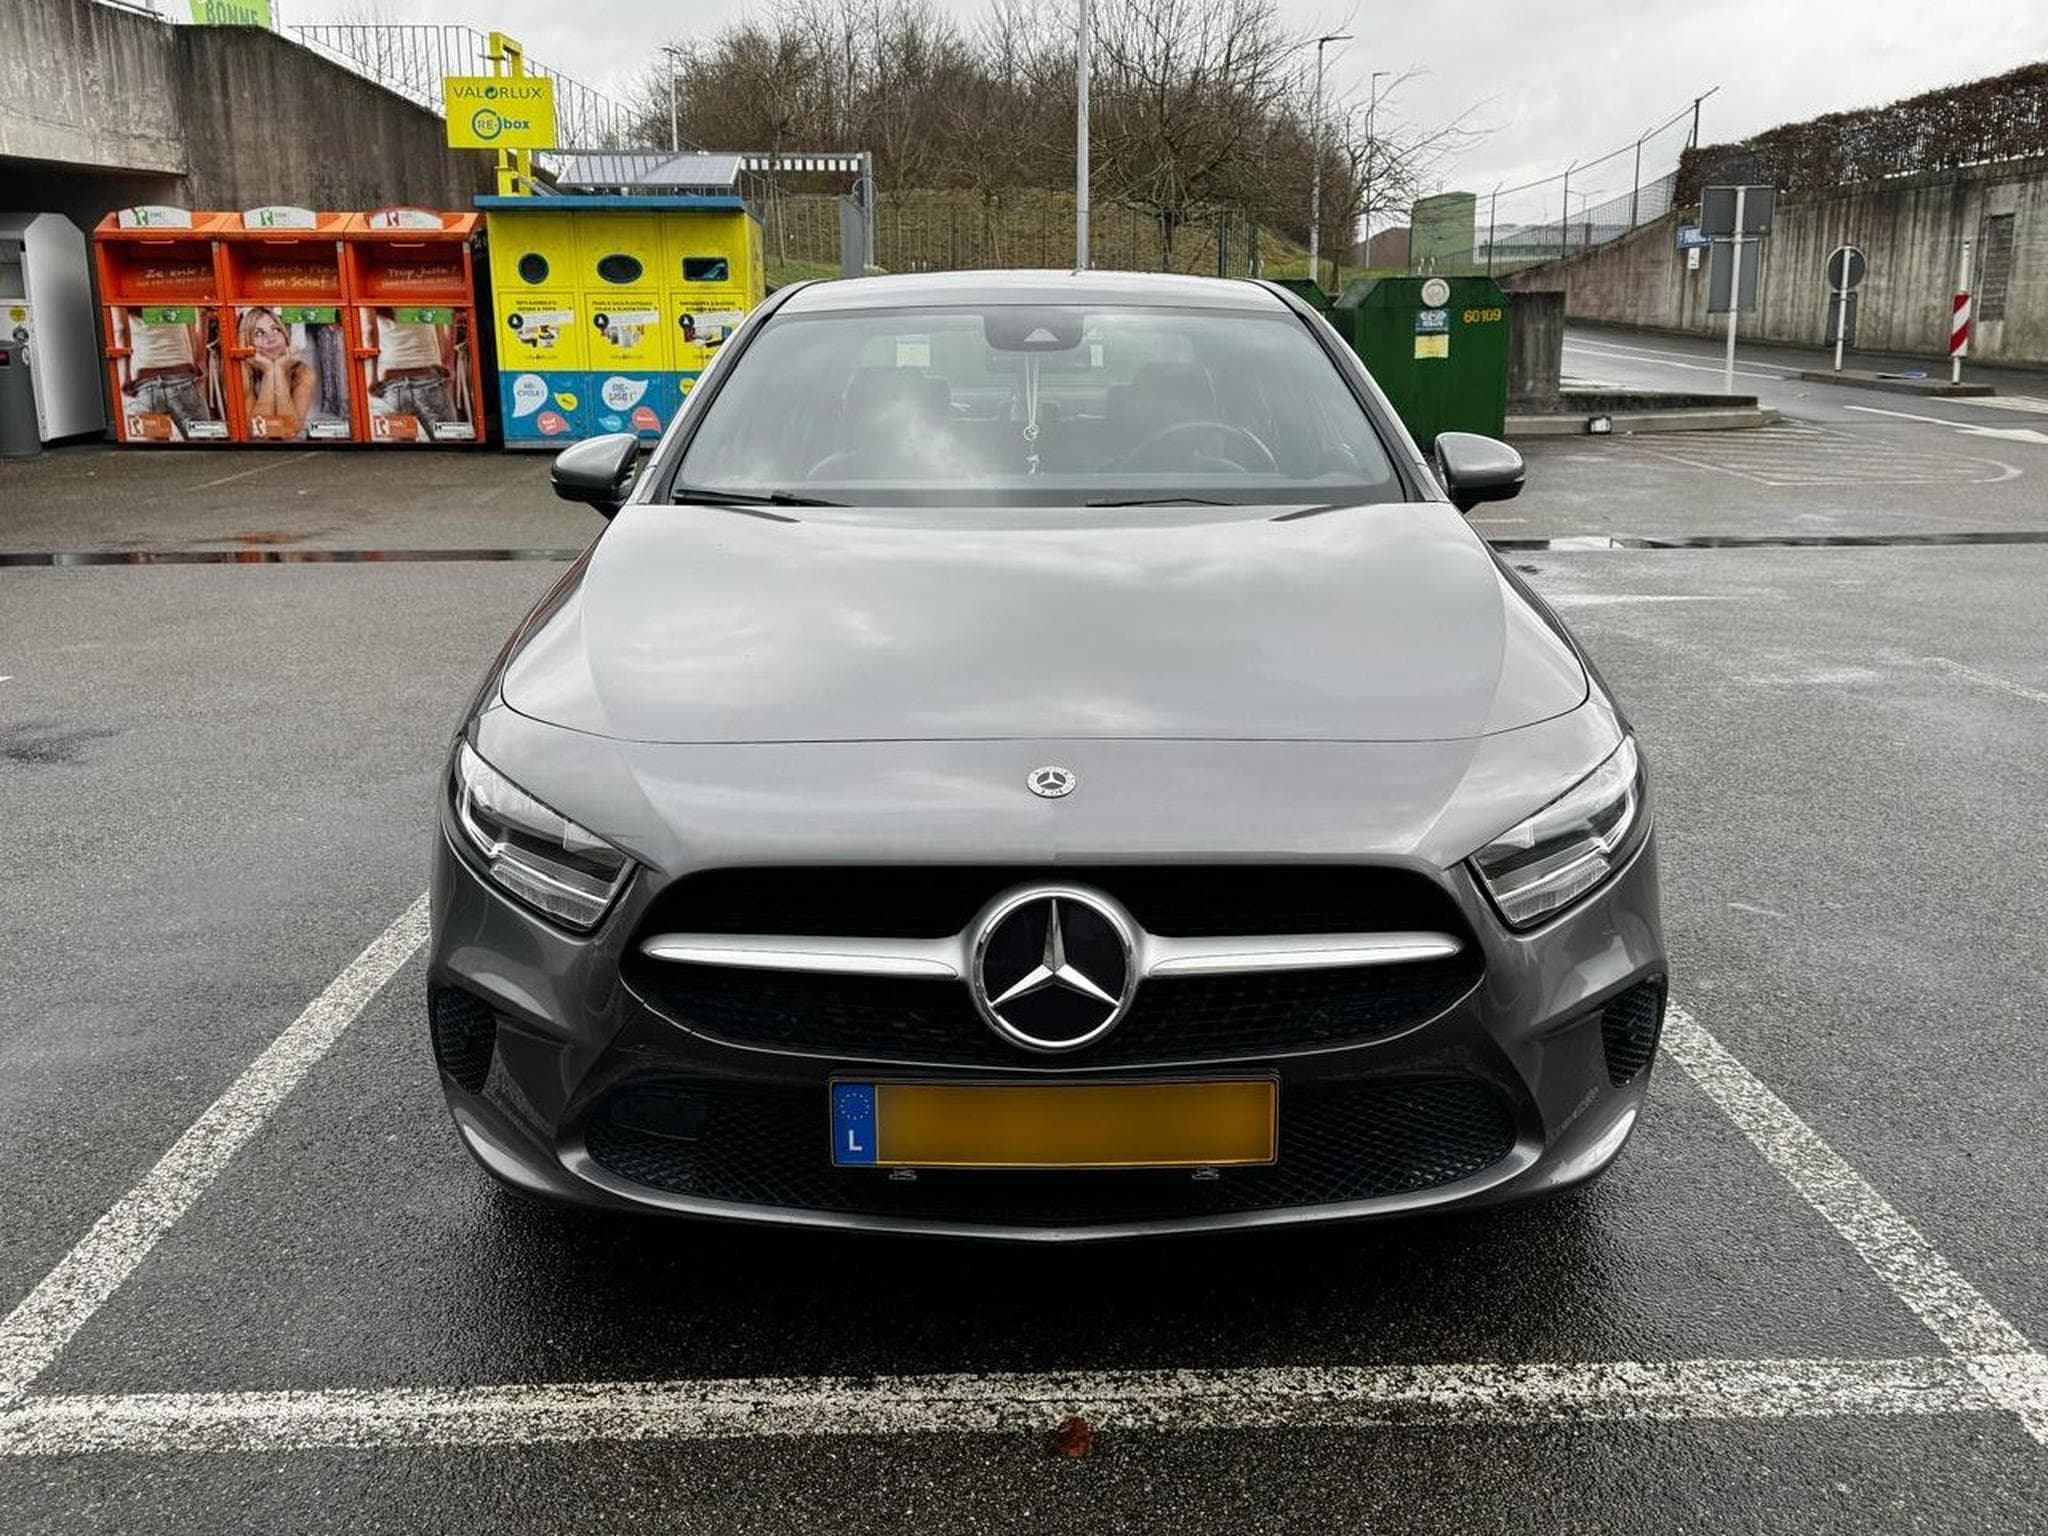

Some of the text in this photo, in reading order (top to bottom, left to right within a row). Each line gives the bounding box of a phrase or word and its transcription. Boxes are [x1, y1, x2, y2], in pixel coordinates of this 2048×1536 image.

[452, 86, 542, 99] VALORLUX
[1464, 308, 1502, 324] 60109
[848, 1129, 863, 1152] L
